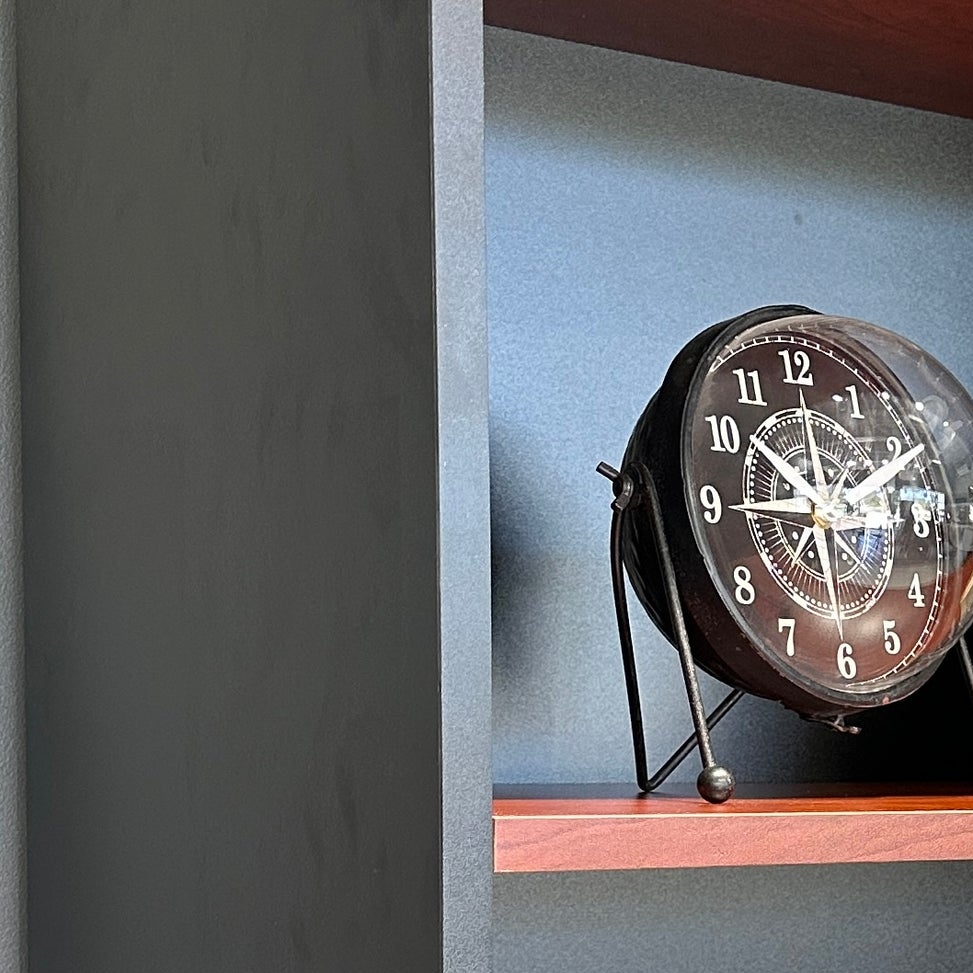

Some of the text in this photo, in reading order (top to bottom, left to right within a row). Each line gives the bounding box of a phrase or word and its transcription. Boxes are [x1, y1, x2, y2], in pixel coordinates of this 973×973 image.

[778, 350, 814, 386] 12
[732, 368, 768, 406] 11
[844, 384, 865, 420] 1
[705, 415, 741, 454] 10
[886, 436, 908, 469] 2
[700, 484, 722, 524] 9
[911, 503, 930, 538] 3
[733, 566, 755, 604] 8
[908, 572, 925, 607] 4
[778, 618, 795, 656] 7
[883, 620, 901, 655] 5
[837, 643, 857, 679] 6
